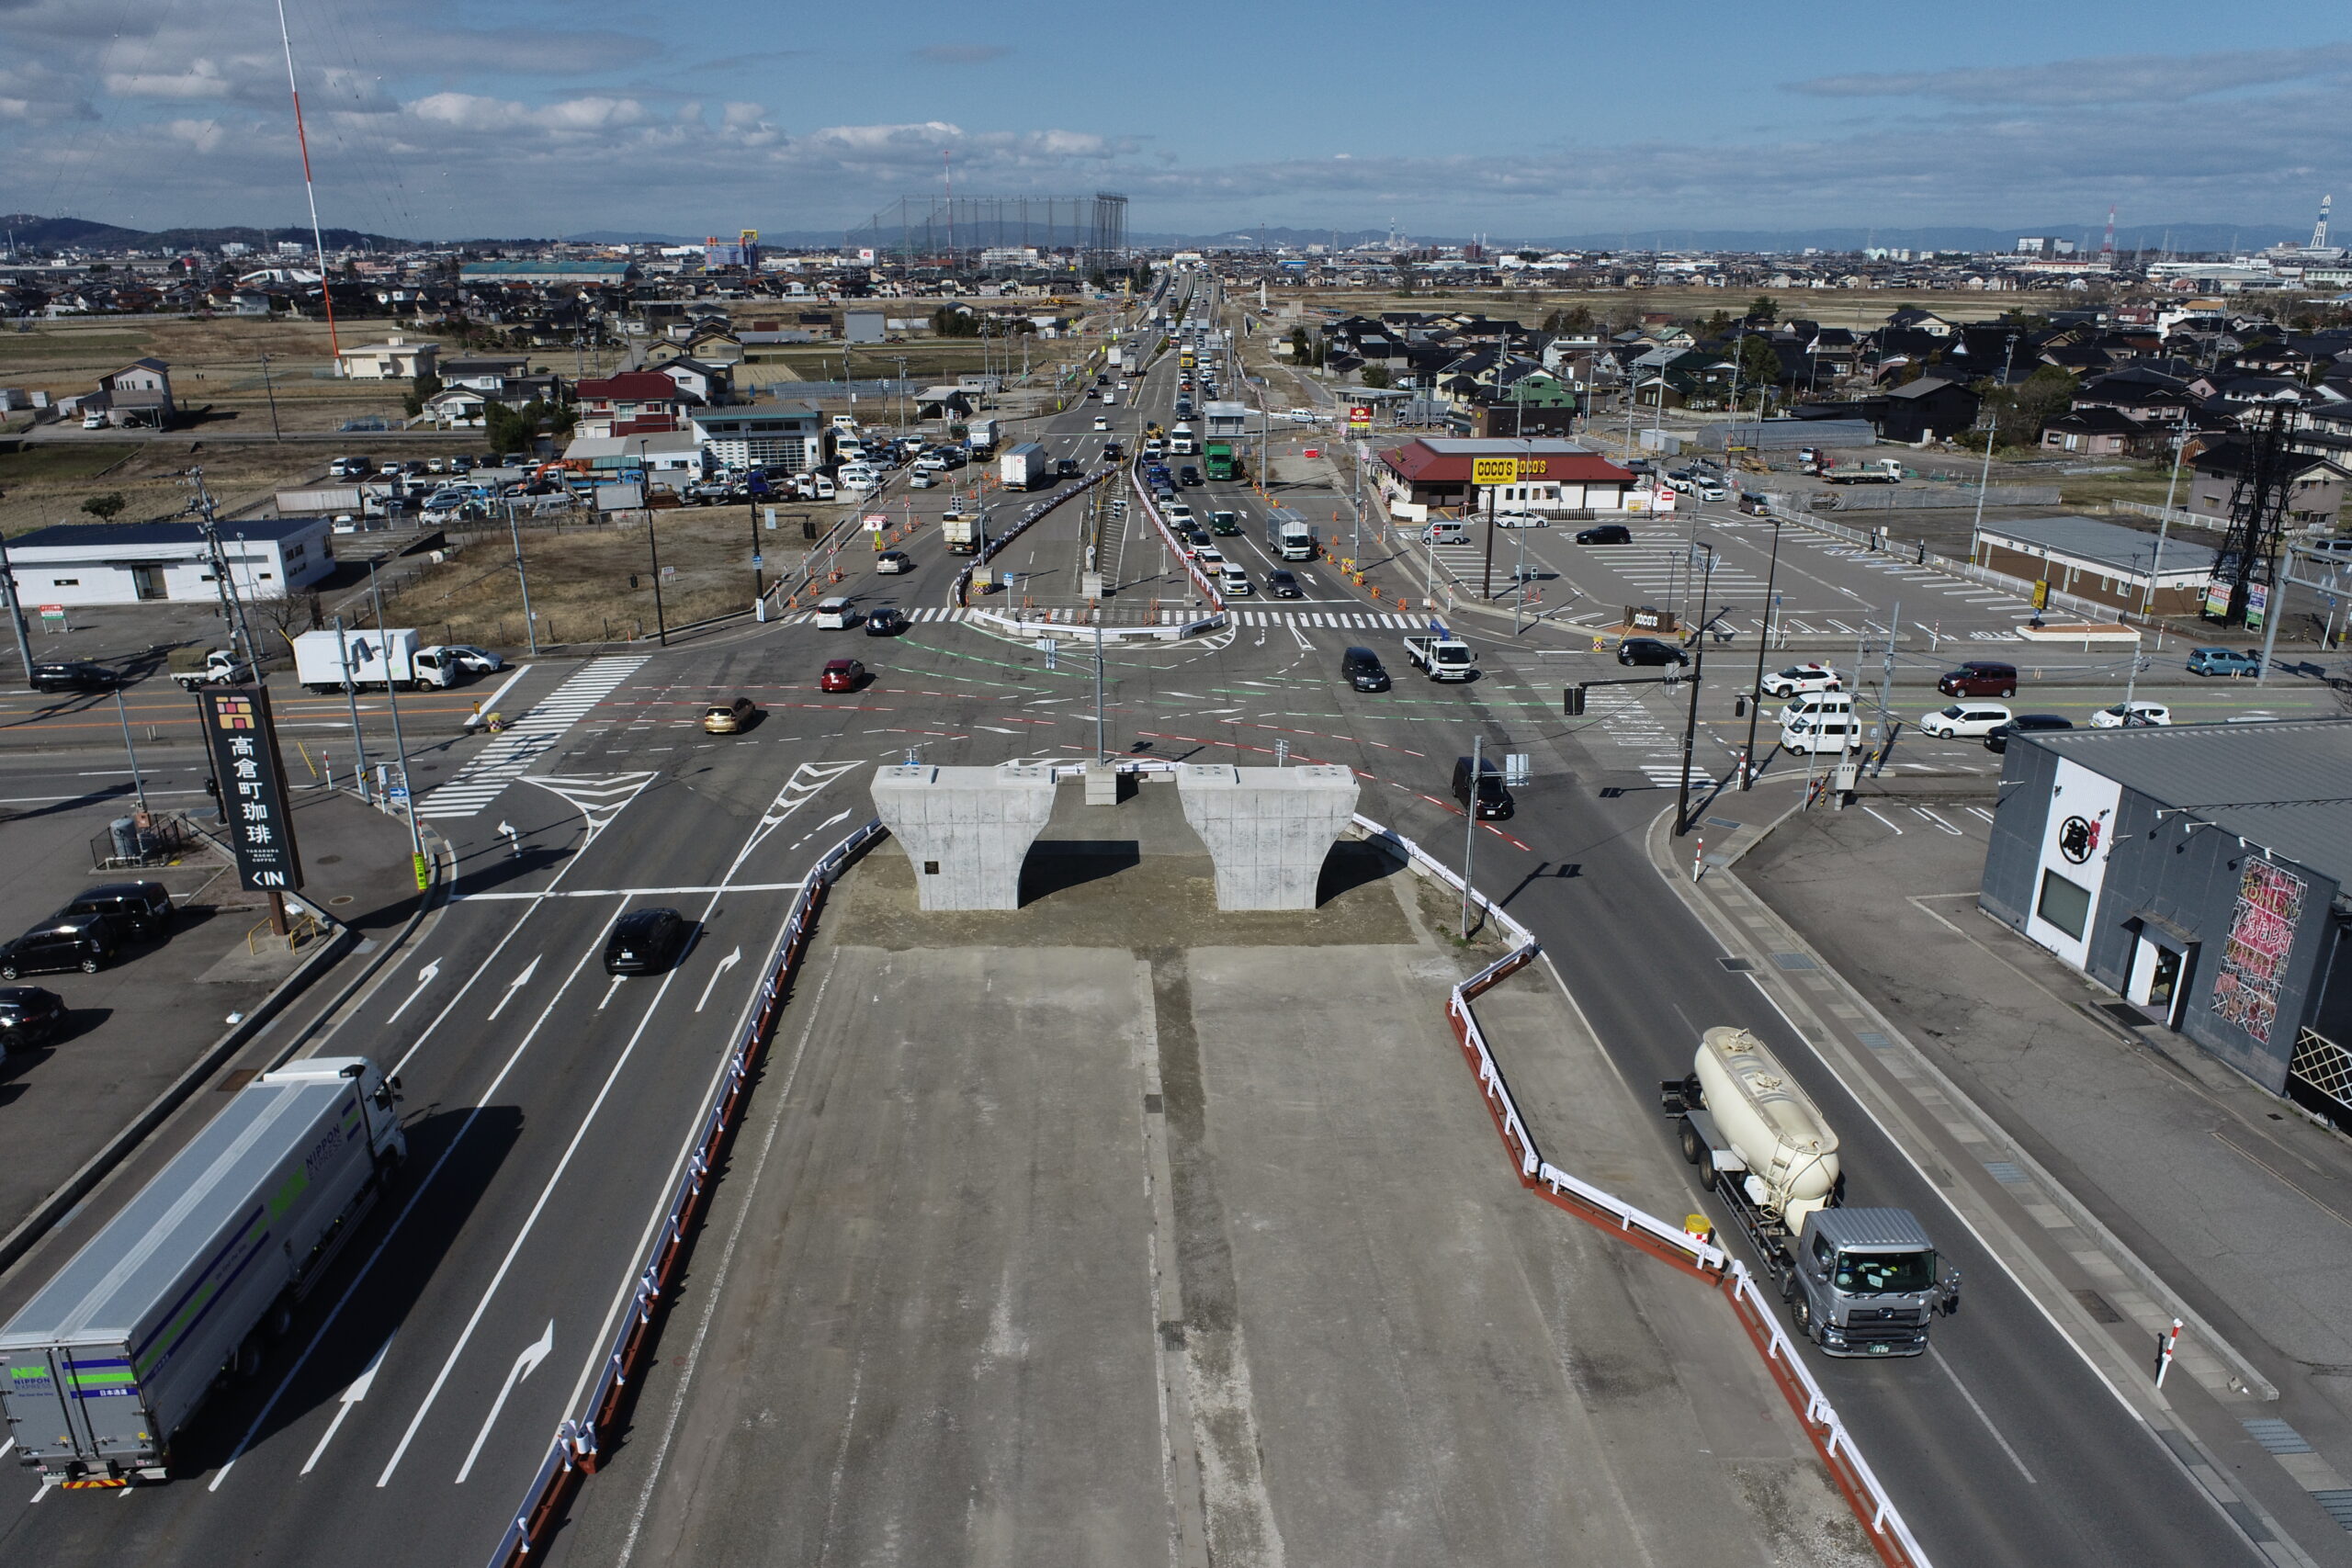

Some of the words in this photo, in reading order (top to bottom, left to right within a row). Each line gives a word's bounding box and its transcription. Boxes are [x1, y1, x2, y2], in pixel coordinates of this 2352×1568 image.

[1477, 461, 1513, 477] COCO'S
[1634, 613, 1658, 626] COCO'S
[228, 736, 273, 844] 高倉町珈琲
[264, 871, 285, 886] IN
[305, 1122, 341, 1168] NIPPON
